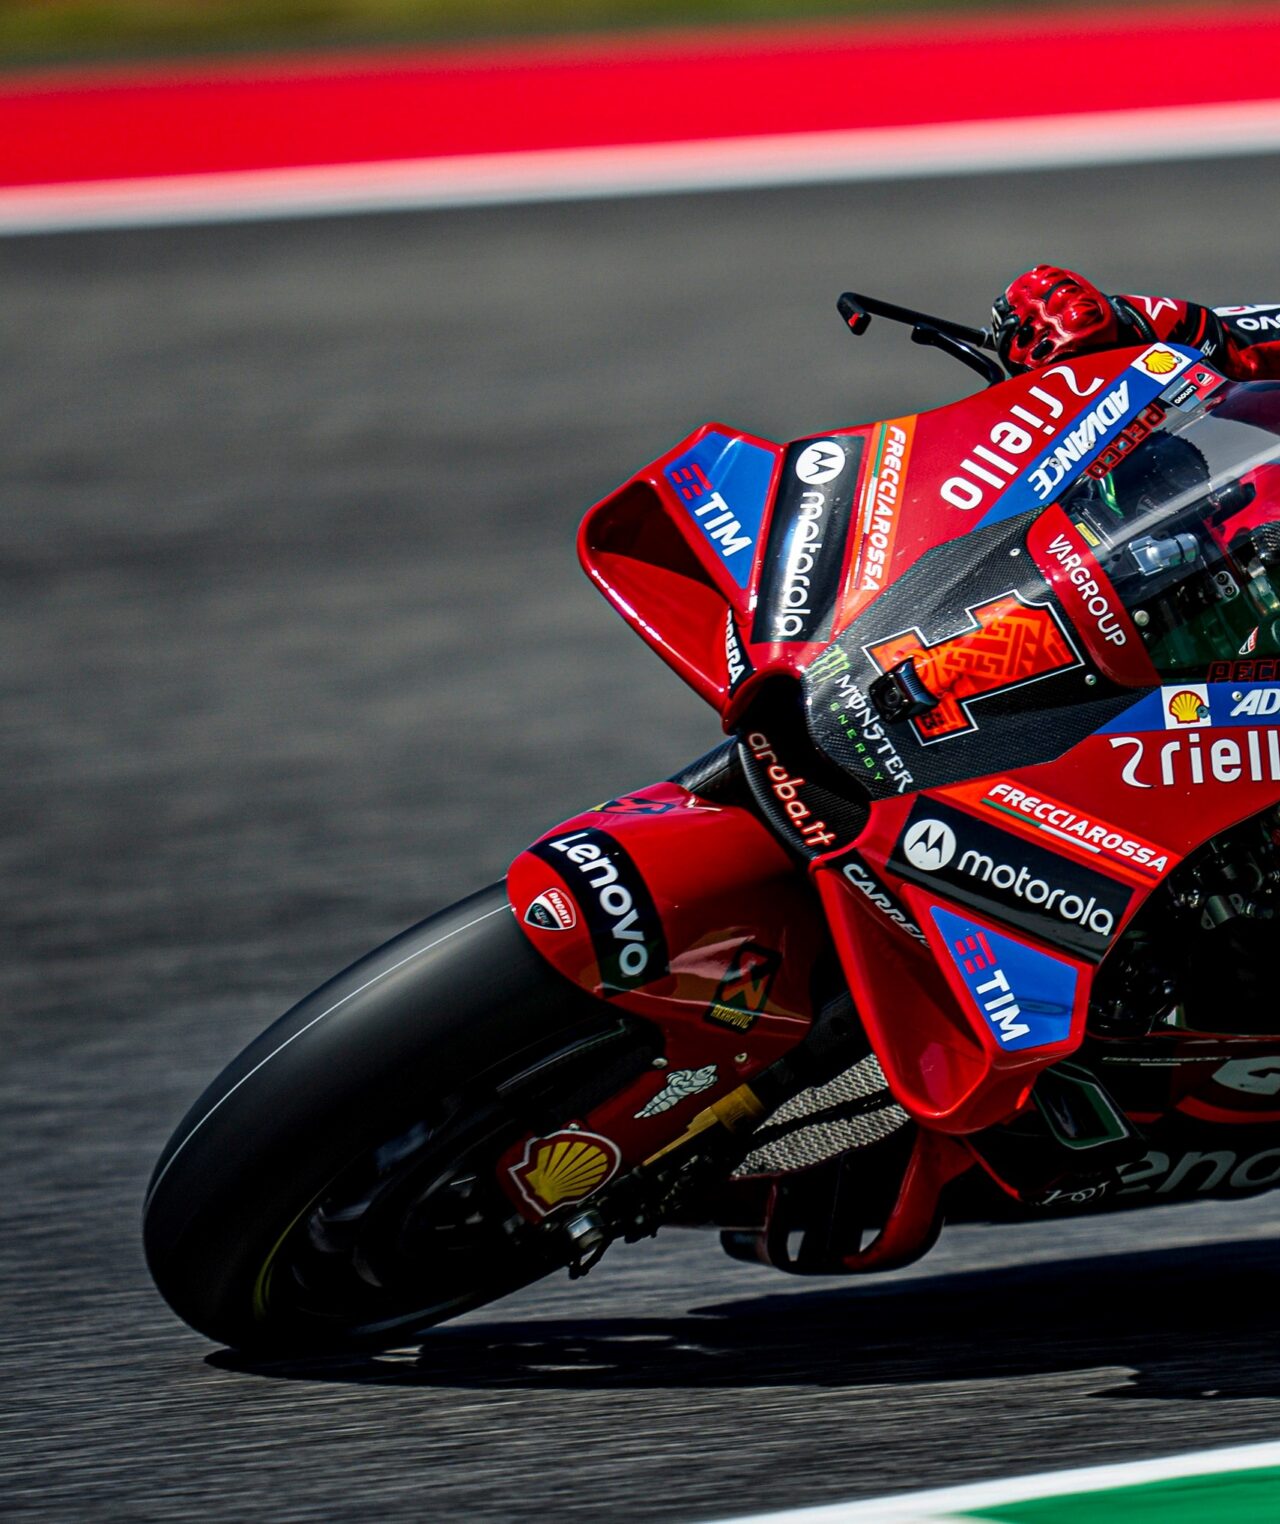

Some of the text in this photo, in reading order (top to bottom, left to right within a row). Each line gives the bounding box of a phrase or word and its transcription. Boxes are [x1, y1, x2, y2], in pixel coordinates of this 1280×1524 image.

[940, 386, 1064, 510] riello
[1027, 380, 1131, 500] ADVANCE
[1085, 403, 1167, 480] PECCO
[694, 491, 753, 557] TIM
[779, 491, 825, 637] motorola
[861, 426, 906, 591] FRECCIAROSSA
[1048, 533, 1127, 647] VARGROUP
[862, 590, 1085, 746] 1
[748, 732, 837, 848] aruba.it
[830, 702, 885, 781] ENERGY
[836, 674, 914, 793] MONSTER
[987, 783, 1169, 873] FRECCIAROSSA
[548, 892, 572, 924] DUCATI
[549, 832, 648, 977] Lenovo
[957, 849, 1114, 937] motorola
[977, 969, 1031, 1042] TIM
